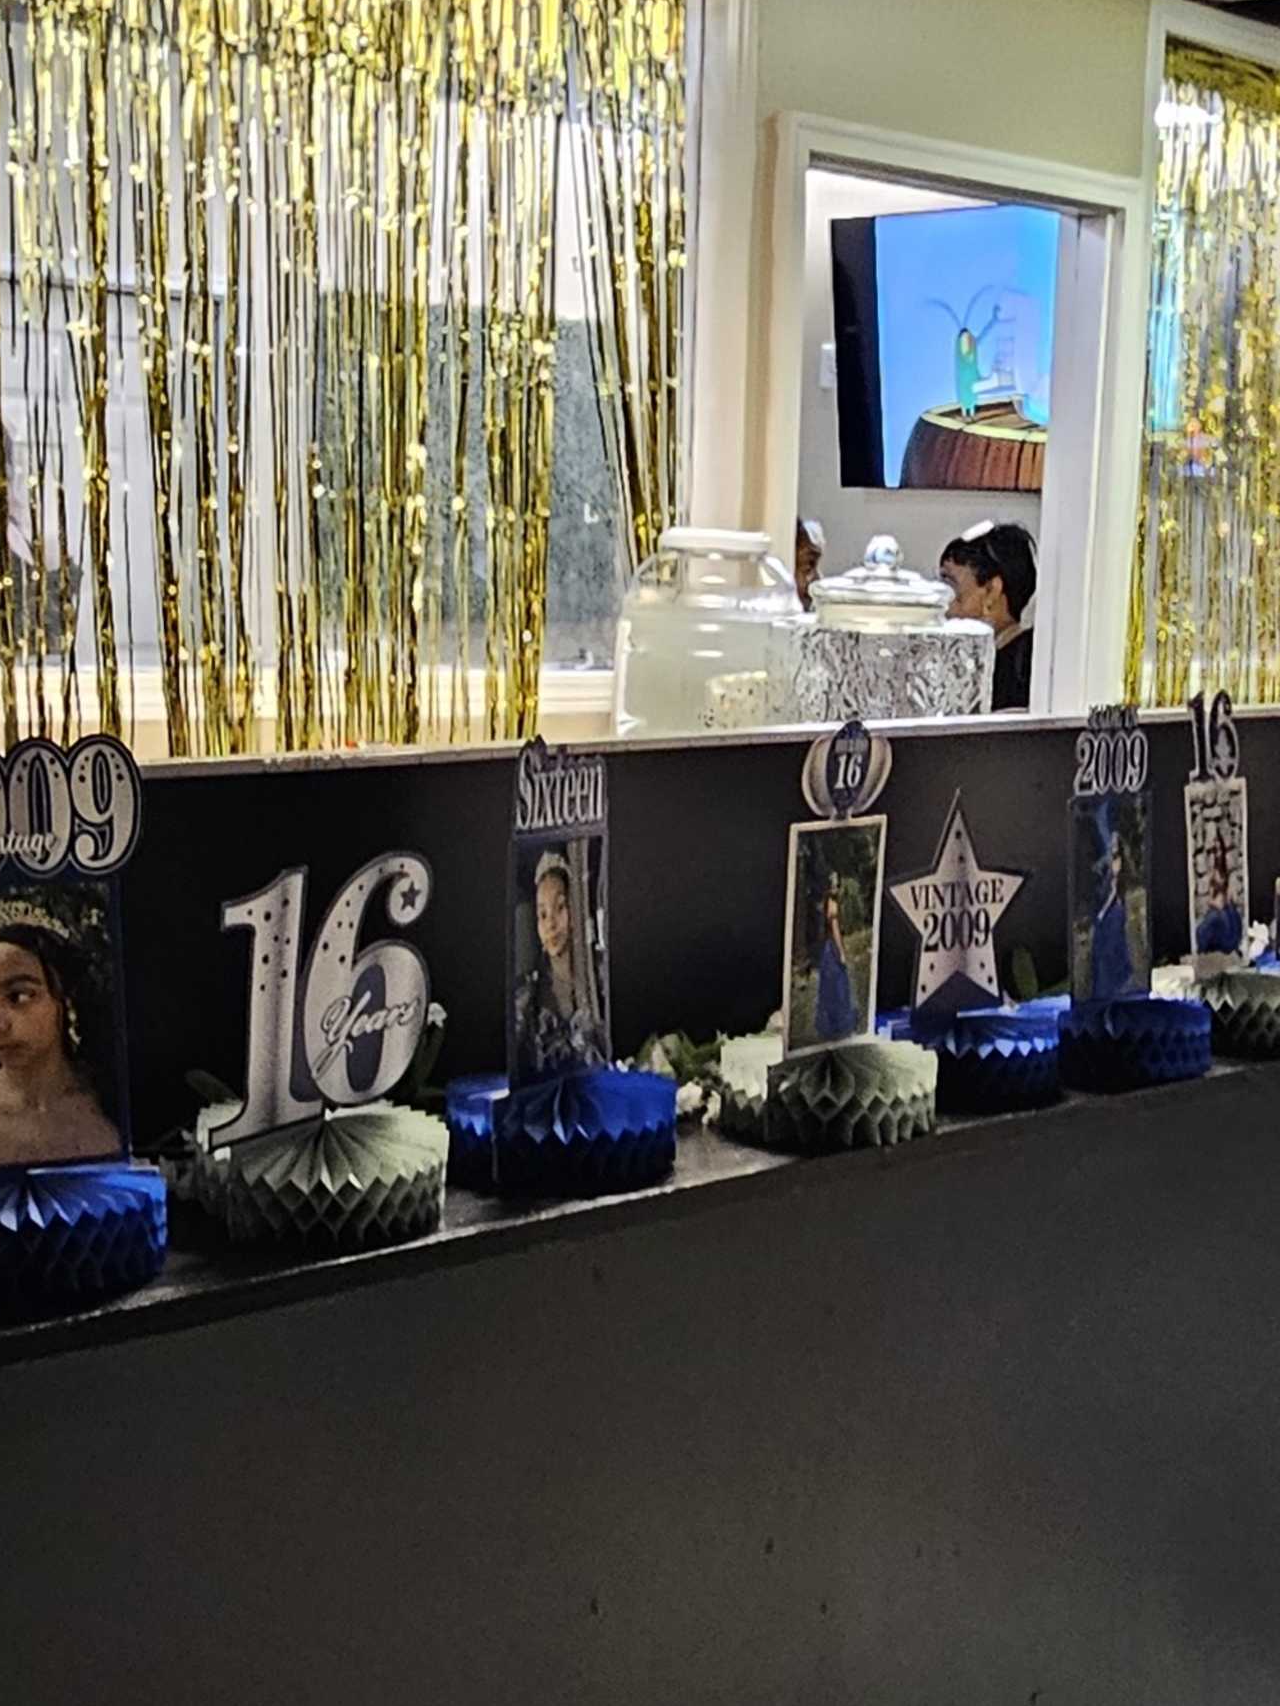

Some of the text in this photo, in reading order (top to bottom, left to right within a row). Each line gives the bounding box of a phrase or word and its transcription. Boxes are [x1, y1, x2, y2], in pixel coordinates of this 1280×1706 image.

[833, 753, 863, 789] 16
[1077, 731, 1145, 793] 2009
[1190, 689, 1237, 781] 16
[516, 746, 603, 830] Sixteen
[910, 877, 1004, 910] VINTAGE
[923, 907, 991, 953] 2009
[209, 850, 432, 1150] 16
[312, 990, 421, 1079] Years
